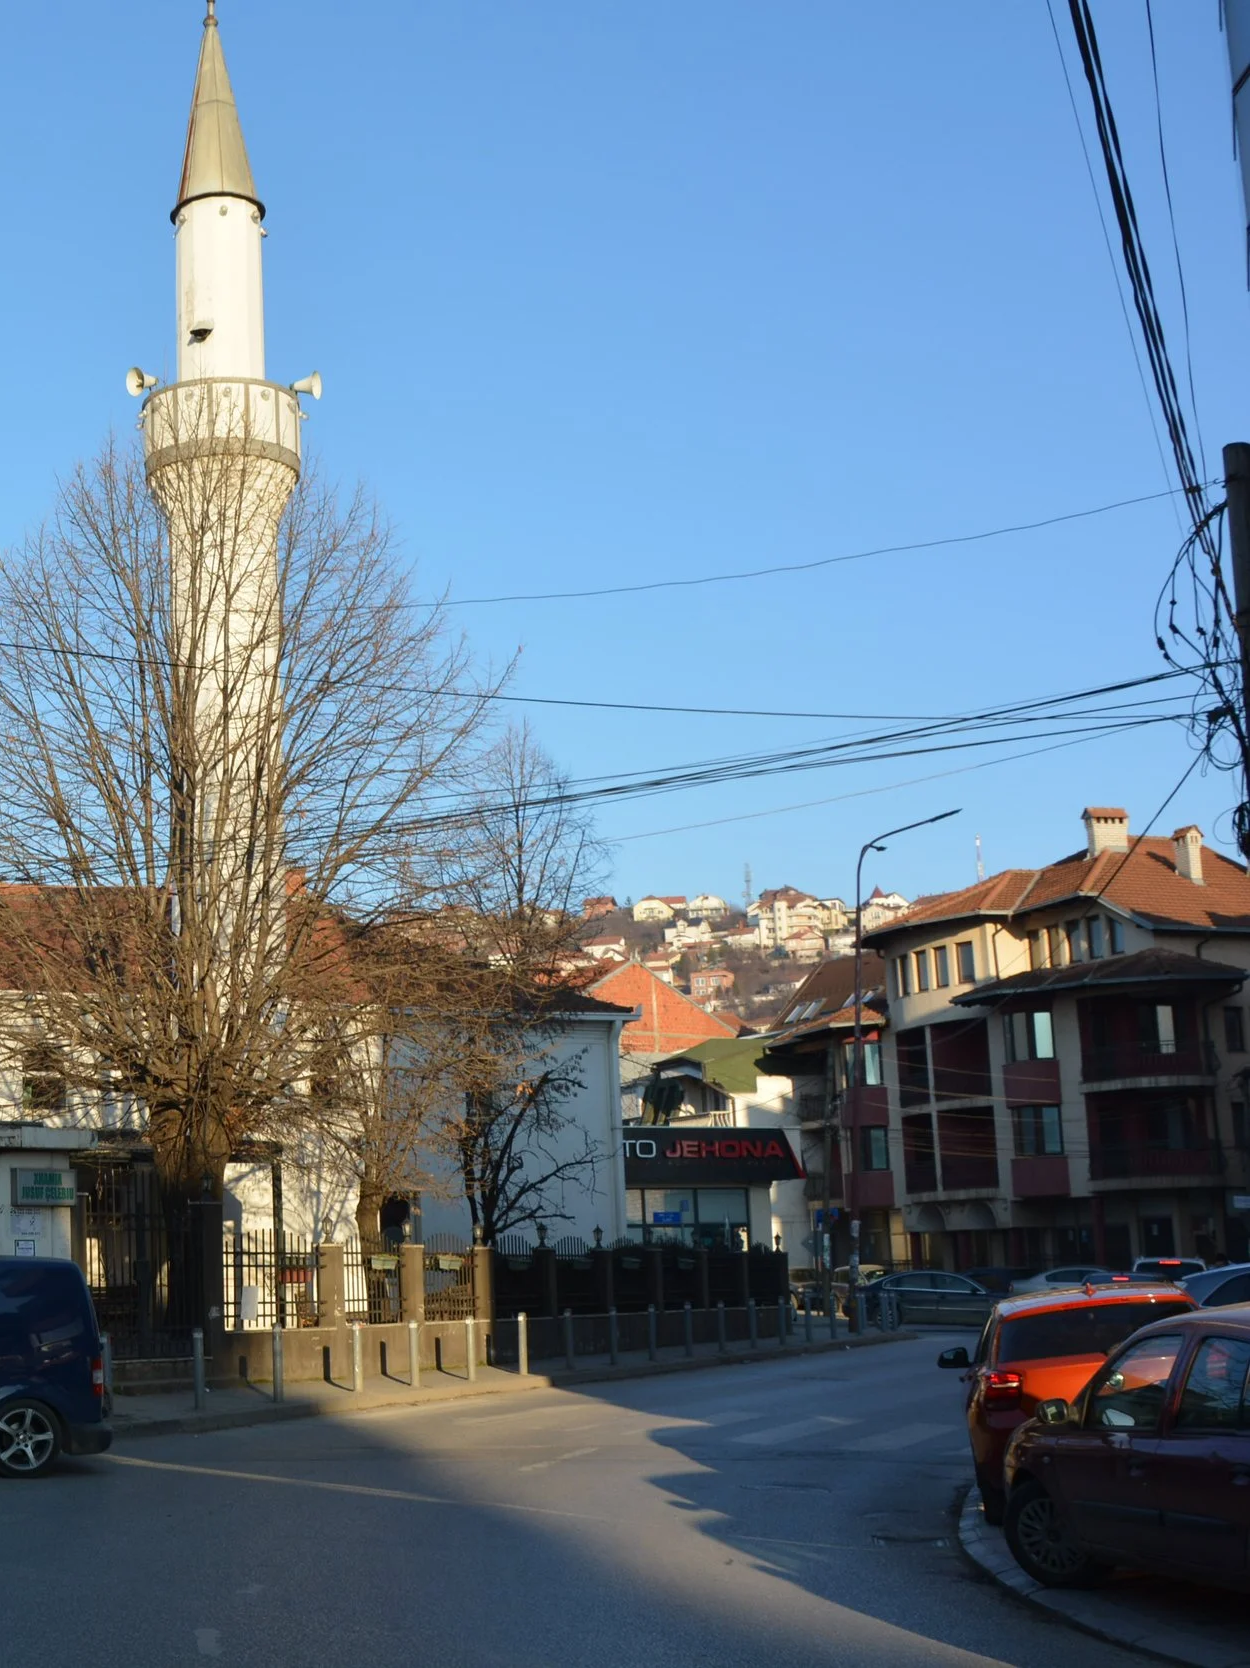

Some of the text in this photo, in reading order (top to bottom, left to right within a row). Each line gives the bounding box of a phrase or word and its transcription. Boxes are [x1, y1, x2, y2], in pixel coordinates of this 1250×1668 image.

[664, 1139, 784, 1158] JEHONA
[33, 1172, 63, 1185] XHAMIA
[22, 1186, 43, 1199] JUSUF
